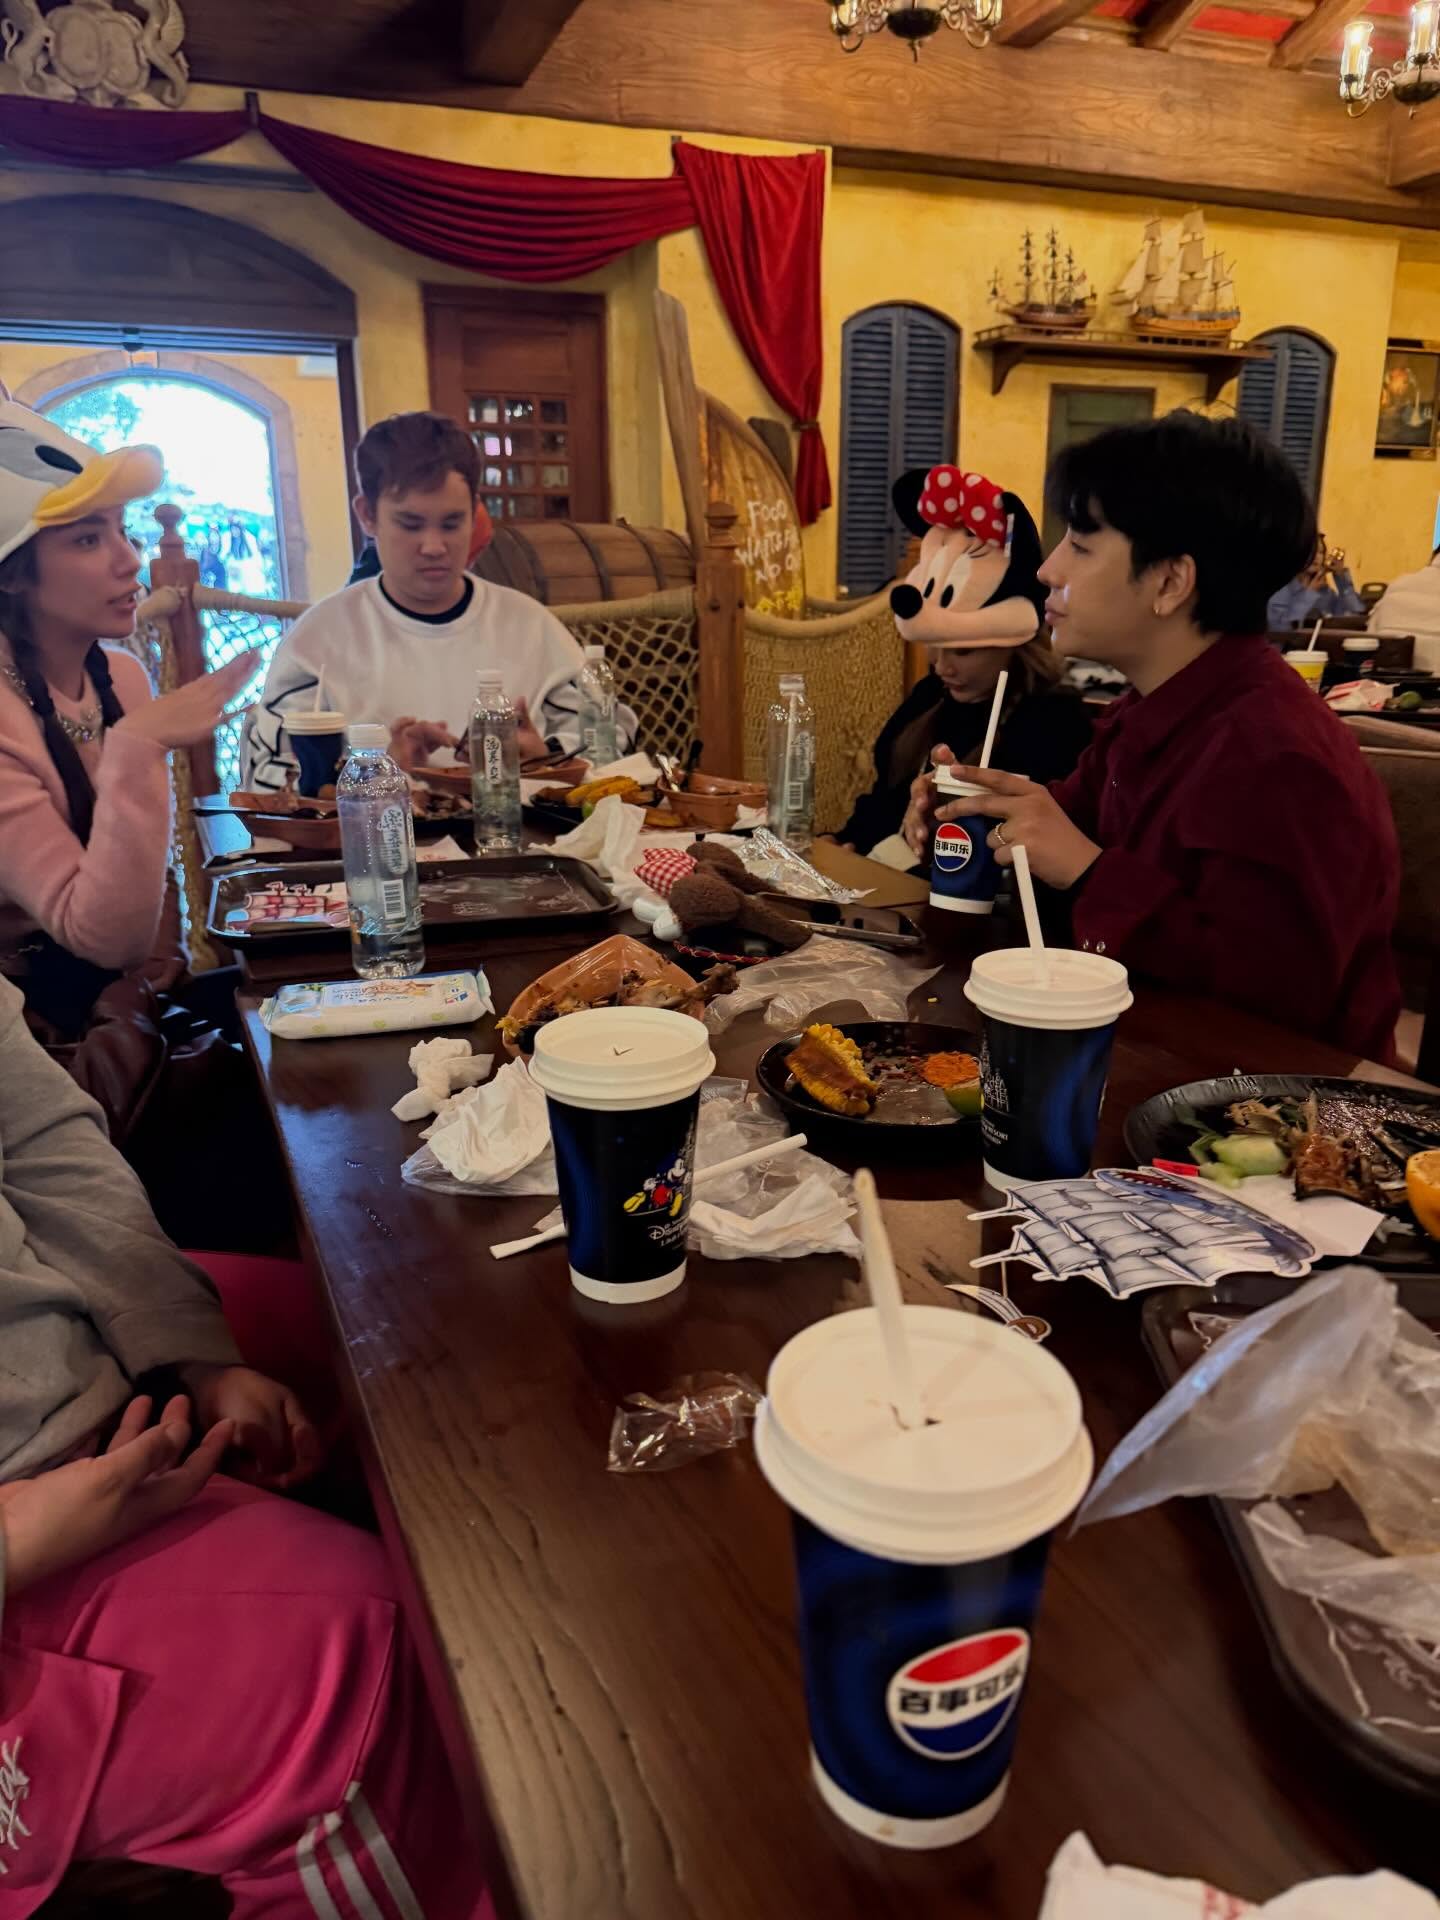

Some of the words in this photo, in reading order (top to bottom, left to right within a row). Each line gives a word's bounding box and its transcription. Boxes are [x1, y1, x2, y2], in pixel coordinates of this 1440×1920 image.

[935, 839, 969, 855] 百事可乐
[898, 1663, 1020, 1715] 百事可乐
